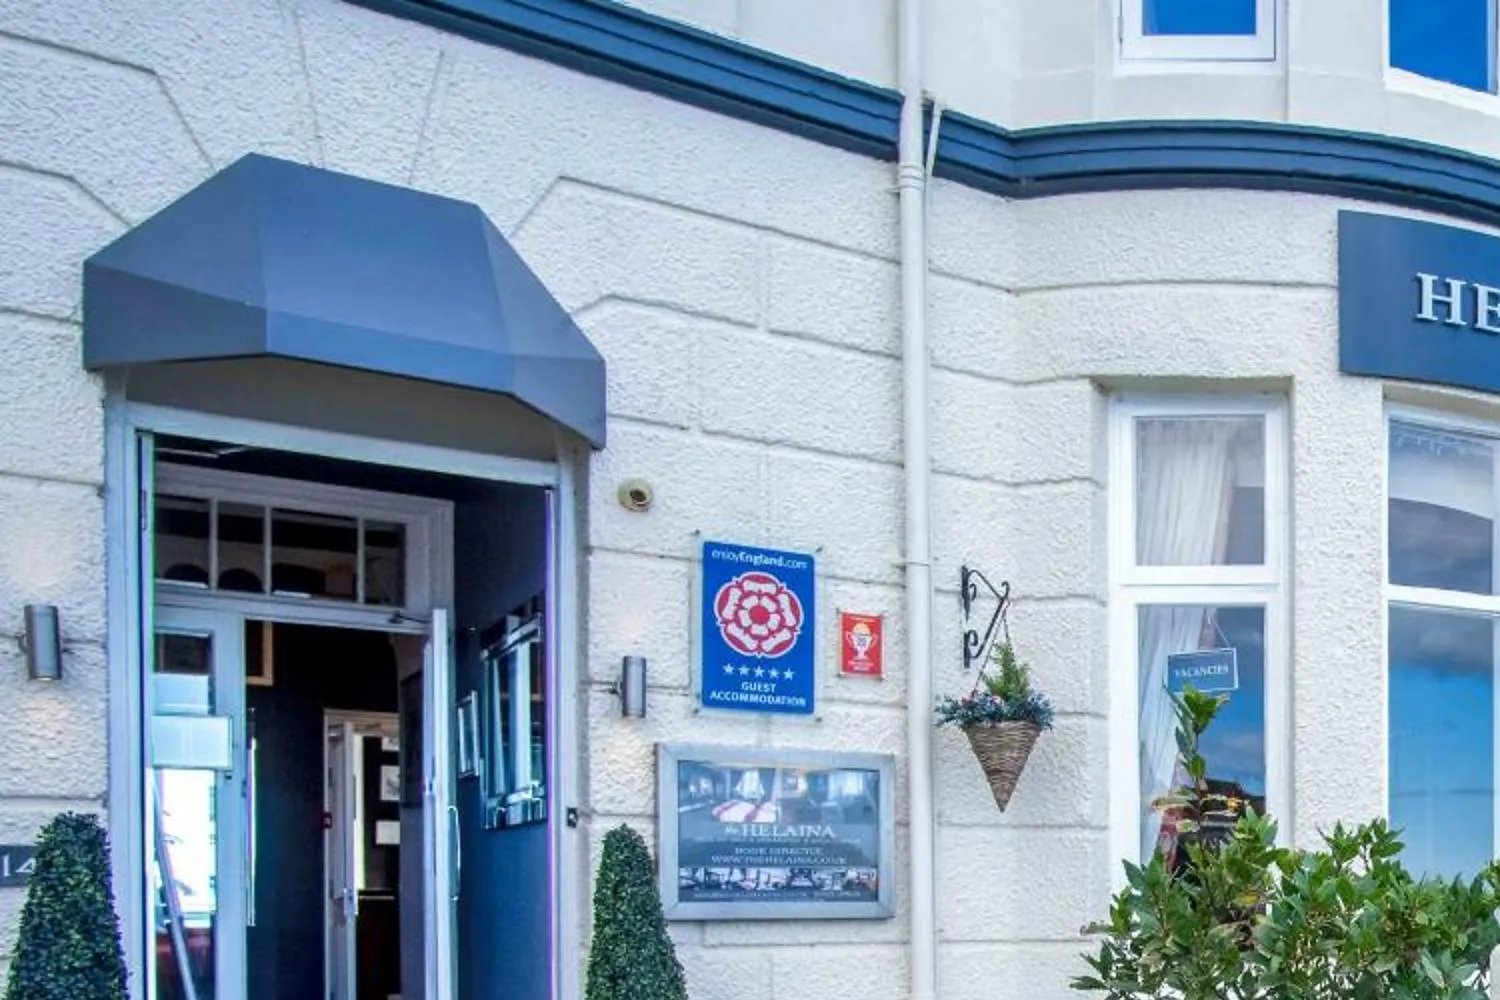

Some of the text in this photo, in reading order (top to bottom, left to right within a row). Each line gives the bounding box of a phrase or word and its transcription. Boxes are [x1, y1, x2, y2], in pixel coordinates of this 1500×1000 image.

[711, 549, 808, 569] enjoyEngland.com
[1173, 664, 1229, 677] VACANCIES
[741, 681, 777, 692] GUEST
[709, 690, 806, 706] ACCOMMODATION
[741, 823, 836, 838] HELAINA
[3, 855, 37, 877] 14
